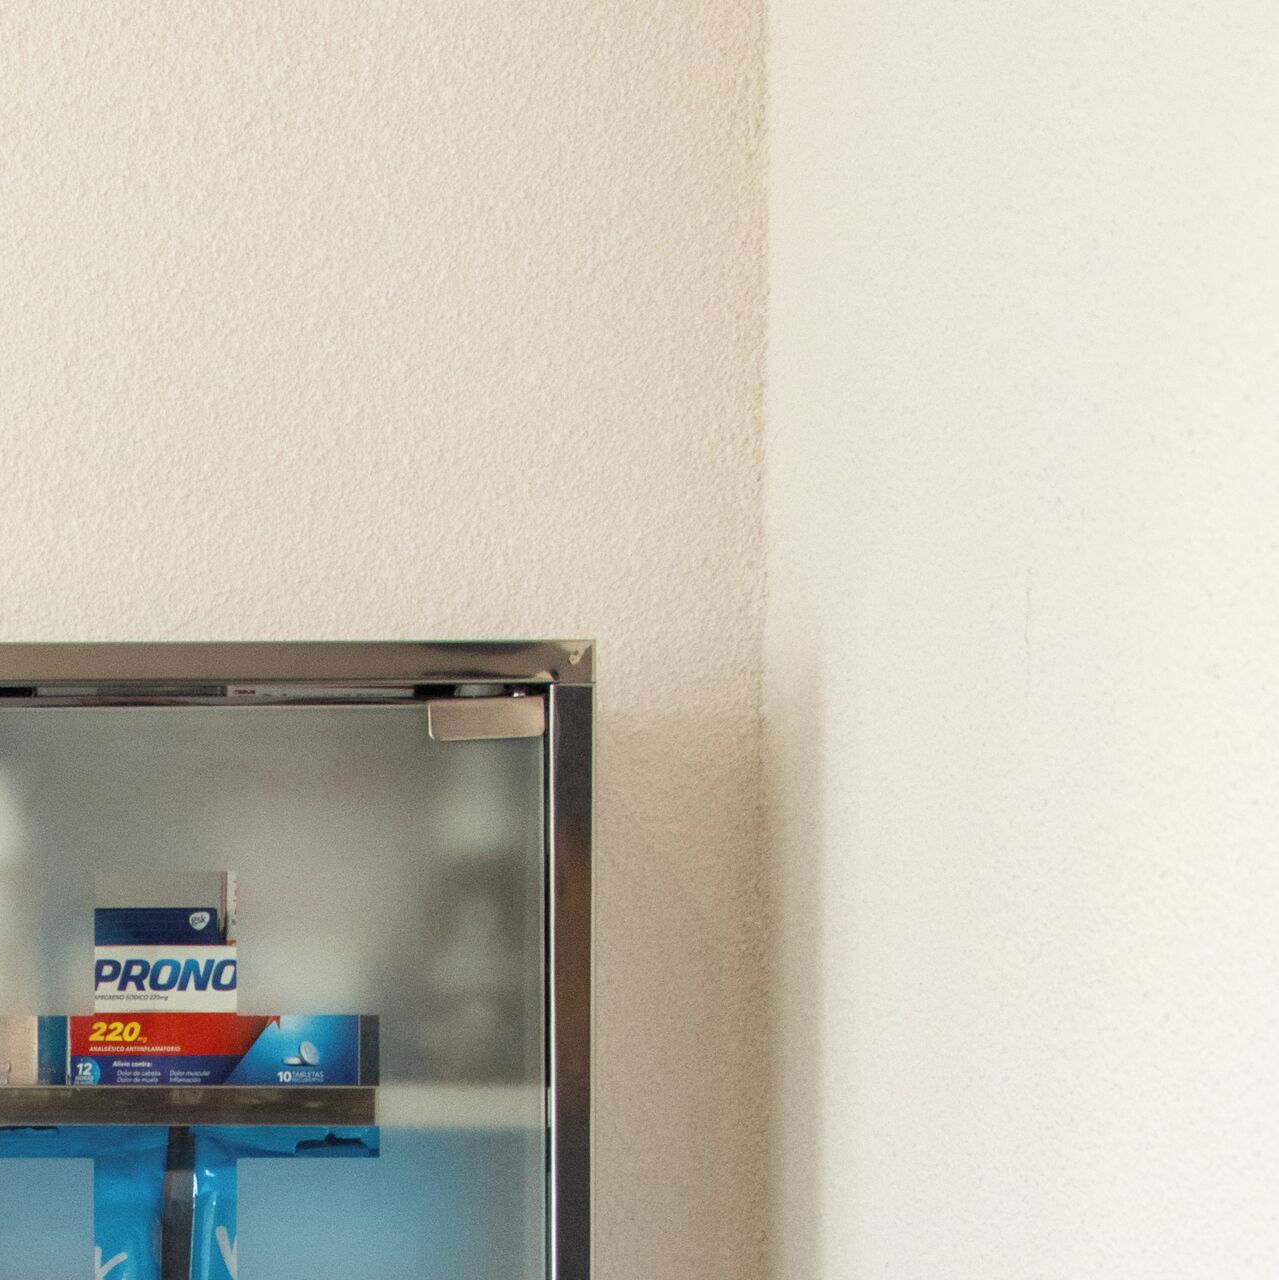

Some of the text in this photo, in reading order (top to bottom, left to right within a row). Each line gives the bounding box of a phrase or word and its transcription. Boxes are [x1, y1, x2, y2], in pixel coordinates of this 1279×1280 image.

[190, 914, 207, 926] gsk
[89, 1045, 182, 1053] ANALGÉSICO ANTIINFLAMATORIO
[76, 1062, 93, 1076] 12
[112, 1060, 130, 1068] Alivio
[277, 1071, 292, 1083] 10
